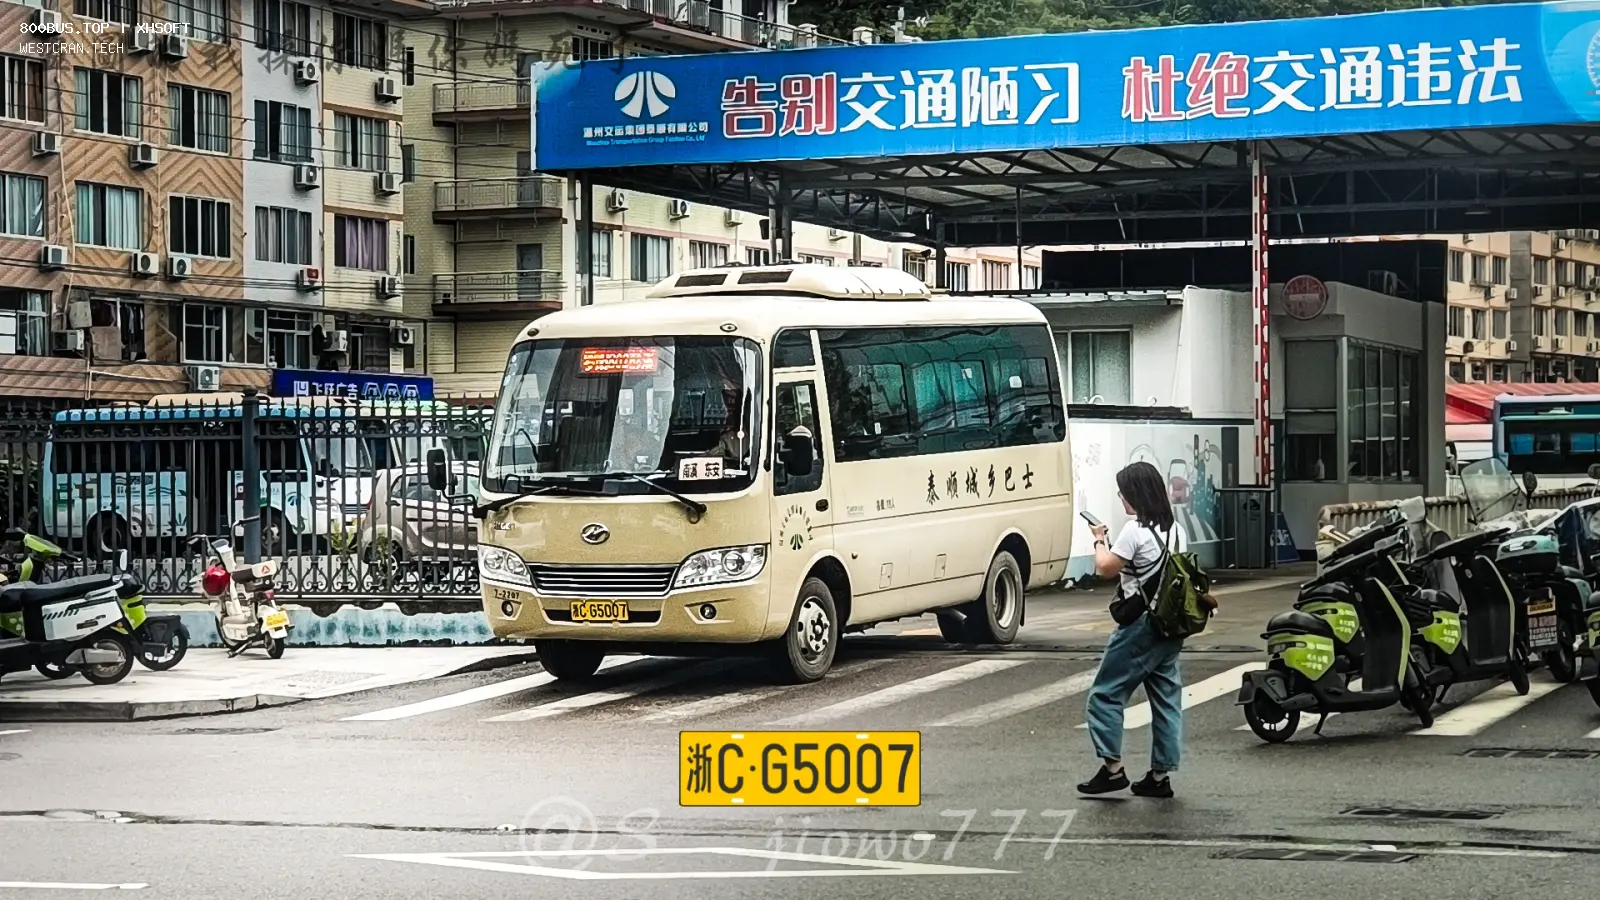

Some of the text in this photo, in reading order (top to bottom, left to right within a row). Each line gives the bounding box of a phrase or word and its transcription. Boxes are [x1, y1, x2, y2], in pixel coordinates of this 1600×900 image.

[721, 37, 1523, 139] 告别交通陋习 杜绝交通违法
[926, 463, 1034, 505] 泰顺城乡巴士
